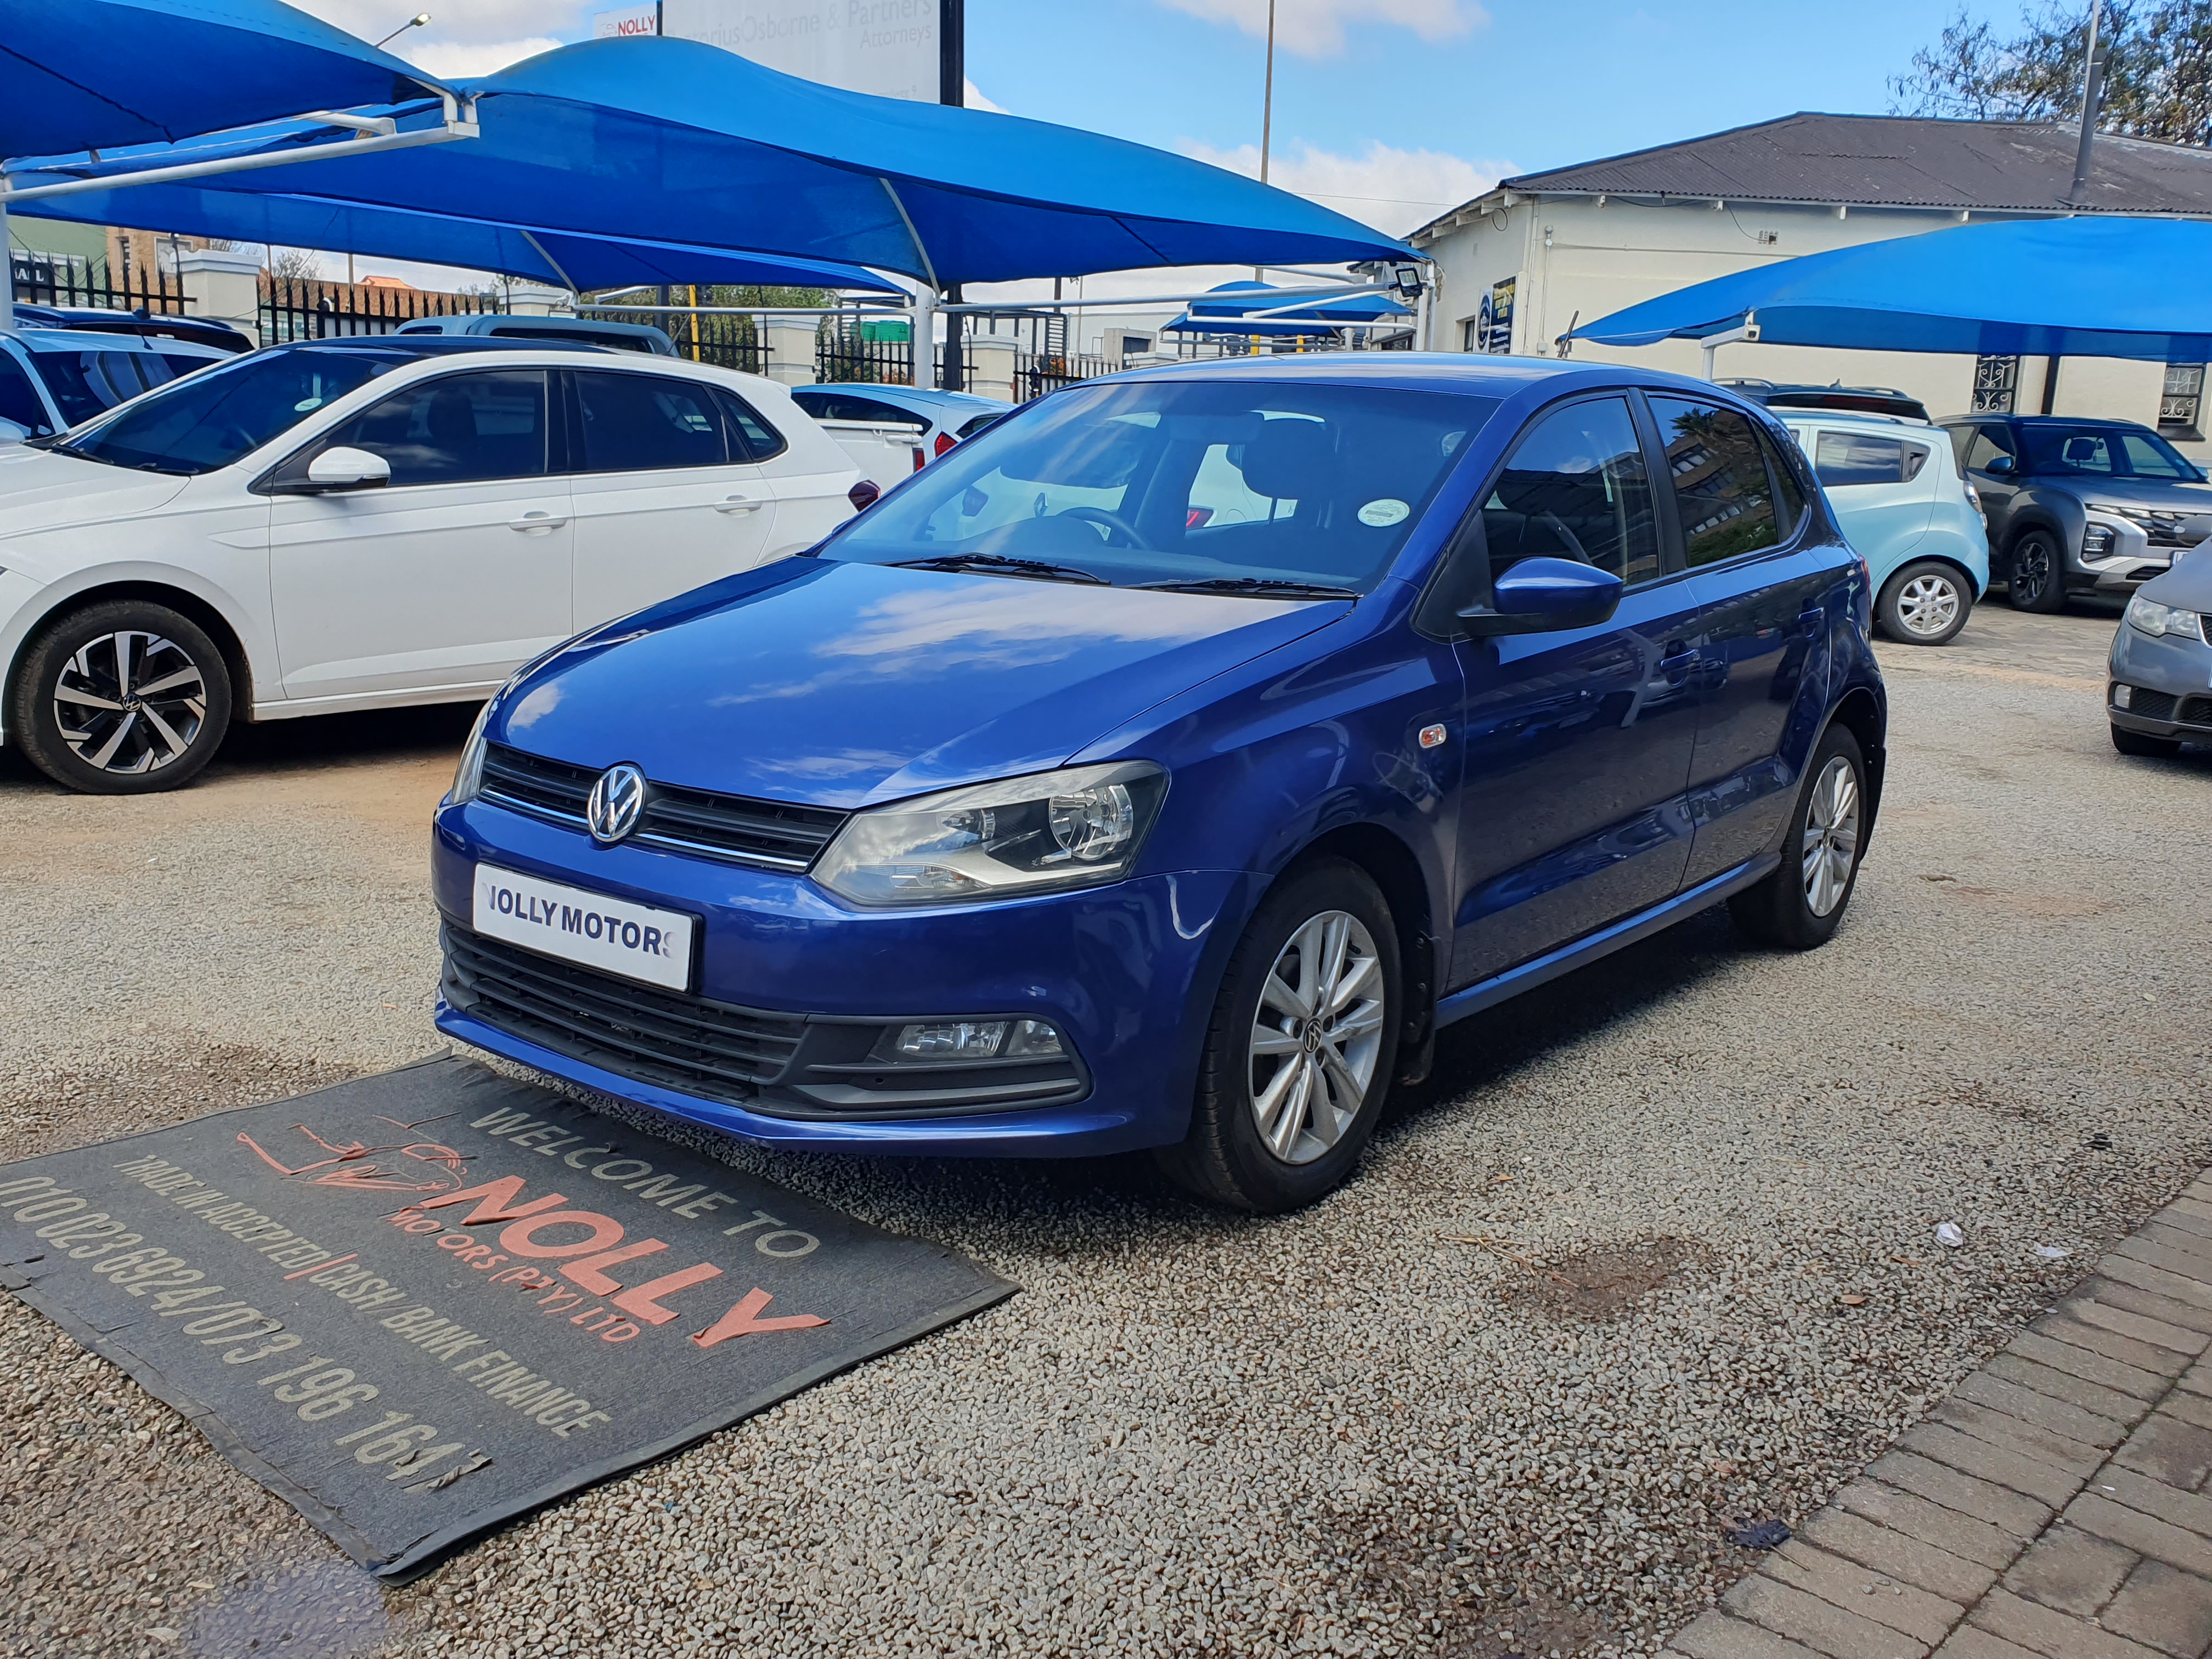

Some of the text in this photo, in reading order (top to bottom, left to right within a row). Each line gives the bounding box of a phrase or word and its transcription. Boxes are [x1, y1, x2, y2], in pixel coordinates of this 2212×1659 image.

[618, 14, 656, 37] NOLLY
[848, 0, 932, 27] Partners
[860, 25, 932, 49] Attorneys
[469, 1107, 821, 1257] WELCOME TO
[112, 1154, 207, 1197] TRADE
[171, 1189, 230, 1211] IN
[452, 1350, 613, 1439] FINANCE
[420, 1174, 833, 1347] NOLLY
[569, 1306, 641, 1342] LTD
[257, 1353, 380, 1422] 196
[334, 1410, 493, 1494] 1647
